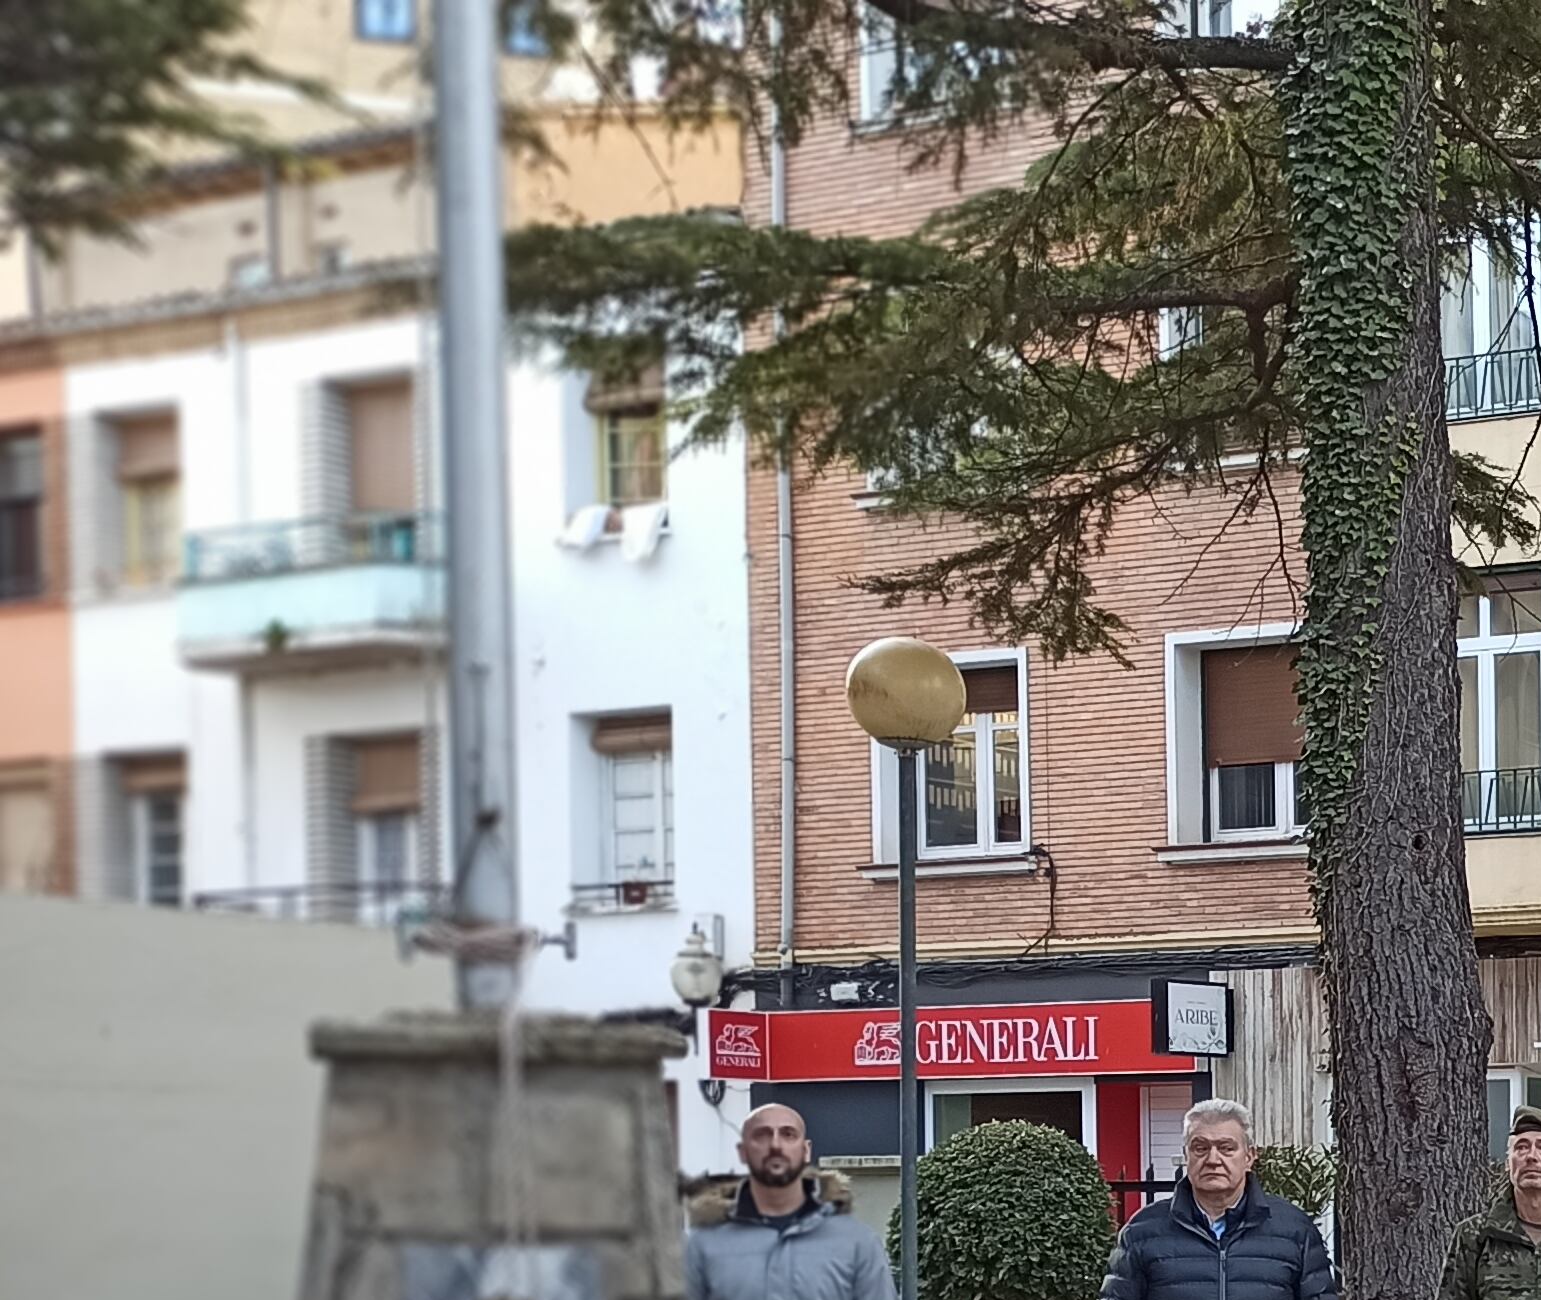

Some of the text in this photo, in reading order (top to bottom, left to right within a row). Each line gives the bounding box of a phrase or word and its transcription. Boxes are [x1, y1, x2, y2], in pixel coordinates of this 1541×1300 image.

[1174, 1007, 1219, 1026] ARIBE
[915, 1015, 1099, 1065] GENERALI
[715, 1055, 761, 1068] GENERALI
